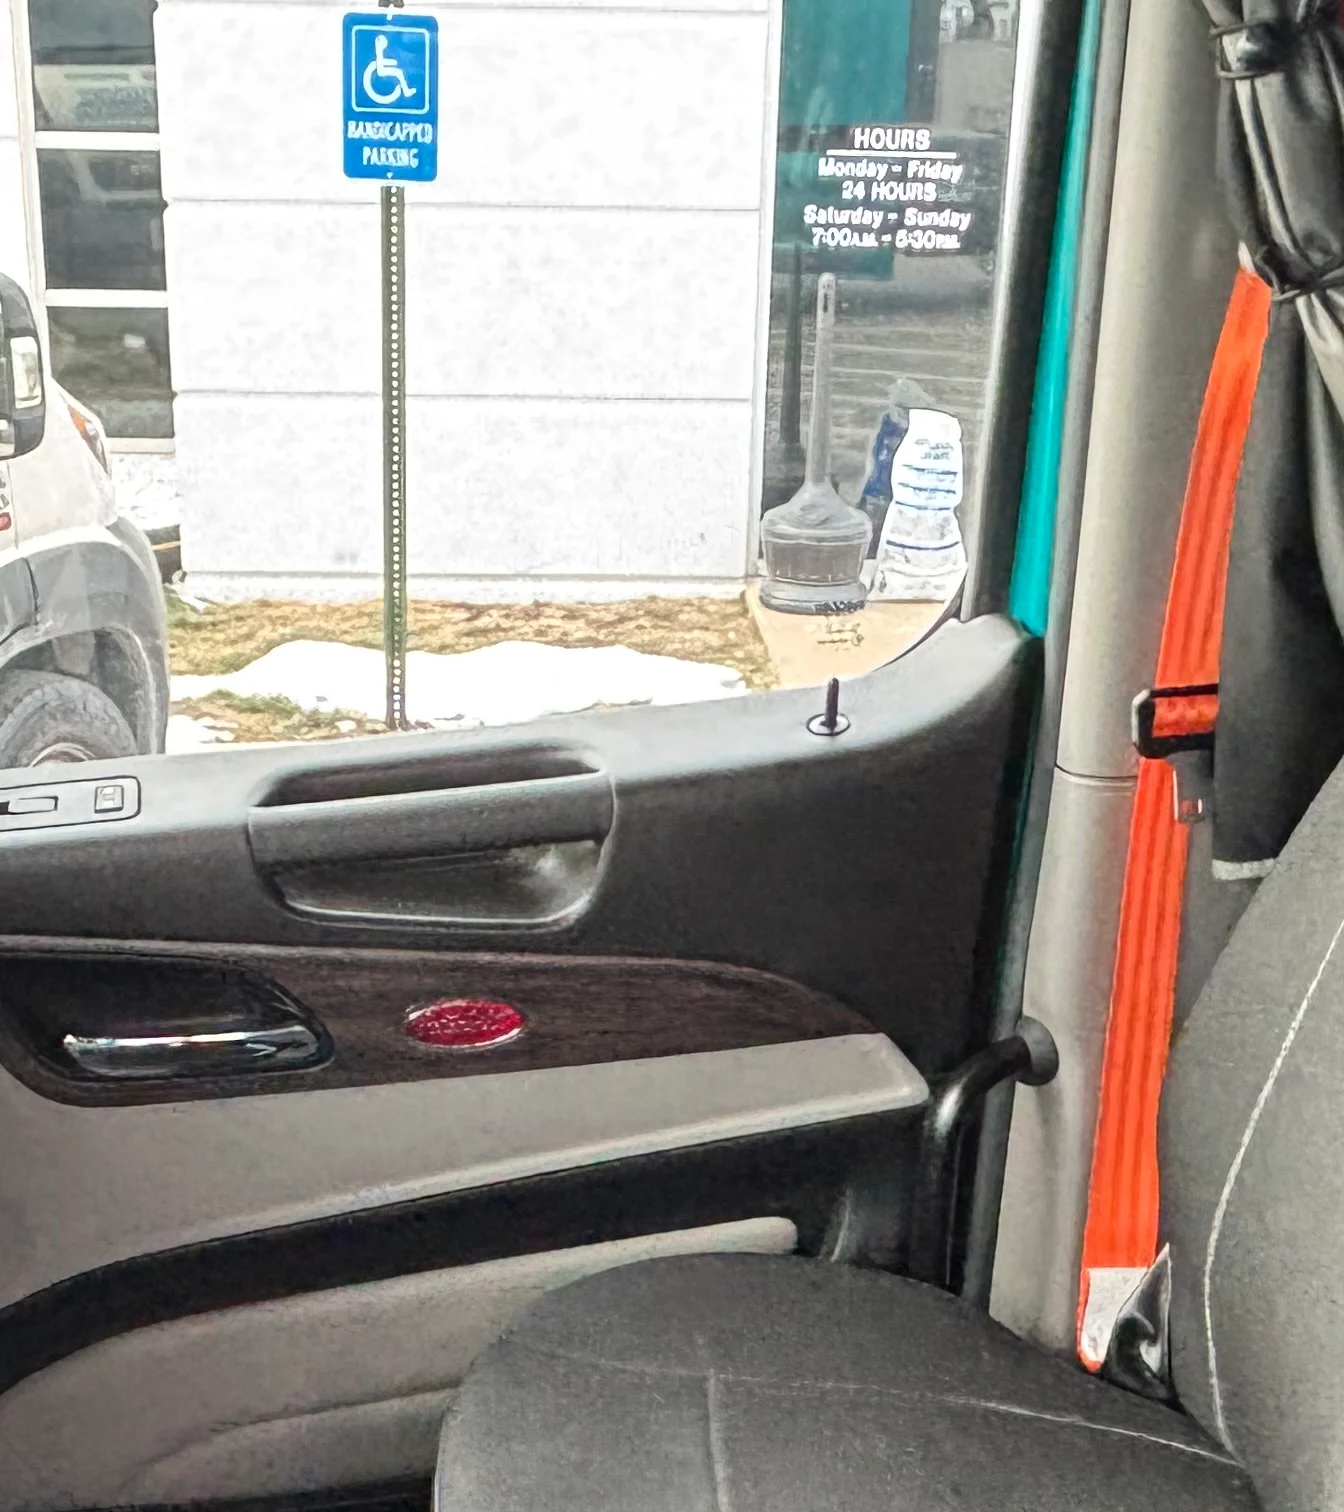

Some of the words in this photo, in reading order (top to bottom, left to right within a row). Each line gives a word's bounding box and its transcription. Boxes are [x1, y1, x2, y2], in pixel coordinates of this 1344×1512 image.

[854, 127, 931, 150] HOURS
[818, 157, 888, 181] Monday
[907, 160, 963, 184] Friday
[842, 180, 866, 200] 24
[871, 181, 937, 202] HOURS
[803, 204, 884, 229] Saturday
[904, 207, 971, 231] Sunday
